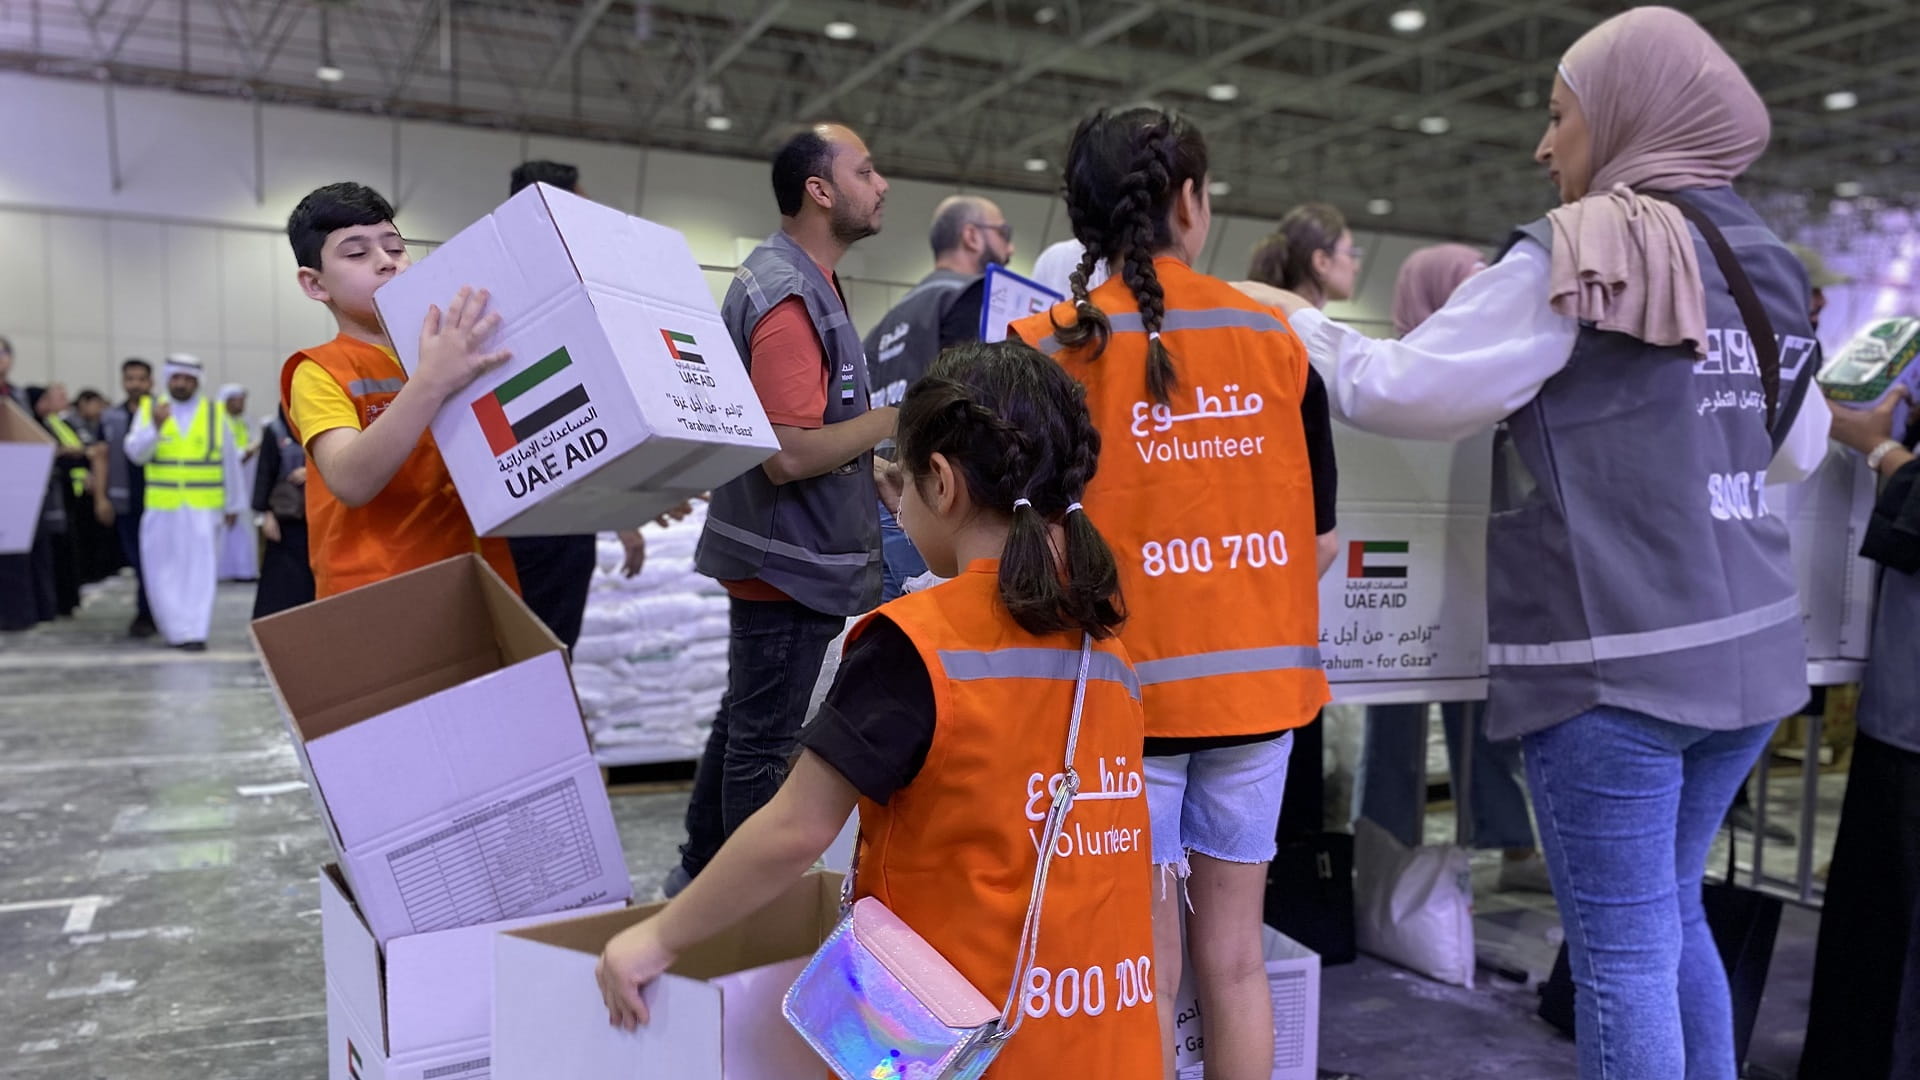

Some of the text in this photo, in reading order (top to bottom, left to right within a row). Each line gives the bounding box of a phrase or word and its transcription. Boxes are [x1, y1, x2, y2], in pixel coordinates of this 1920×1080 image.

[678, 370, 716, 388] UAE AID
[1131, 384, 1263, 437] متطوع
[497, 406, 598, 474] المساعدات الإماراتية
[721, 422, 734, 435] for
[504, 427, 608, 499] UAE AID
[1136, 435, 1265, 464] Volunteer
[1142, 530, 1289, 577] 800 700
[1343, 593, 1407, 609] UAE AID
[1334, 620, 1359, 646] أجل
[1362, 629, 1384, 646] من
[1376, 653, 1398, 669] for
[1400, 652, 1438, 668] Gaza"
[1024, 955, 1154, 1019] 800 700
